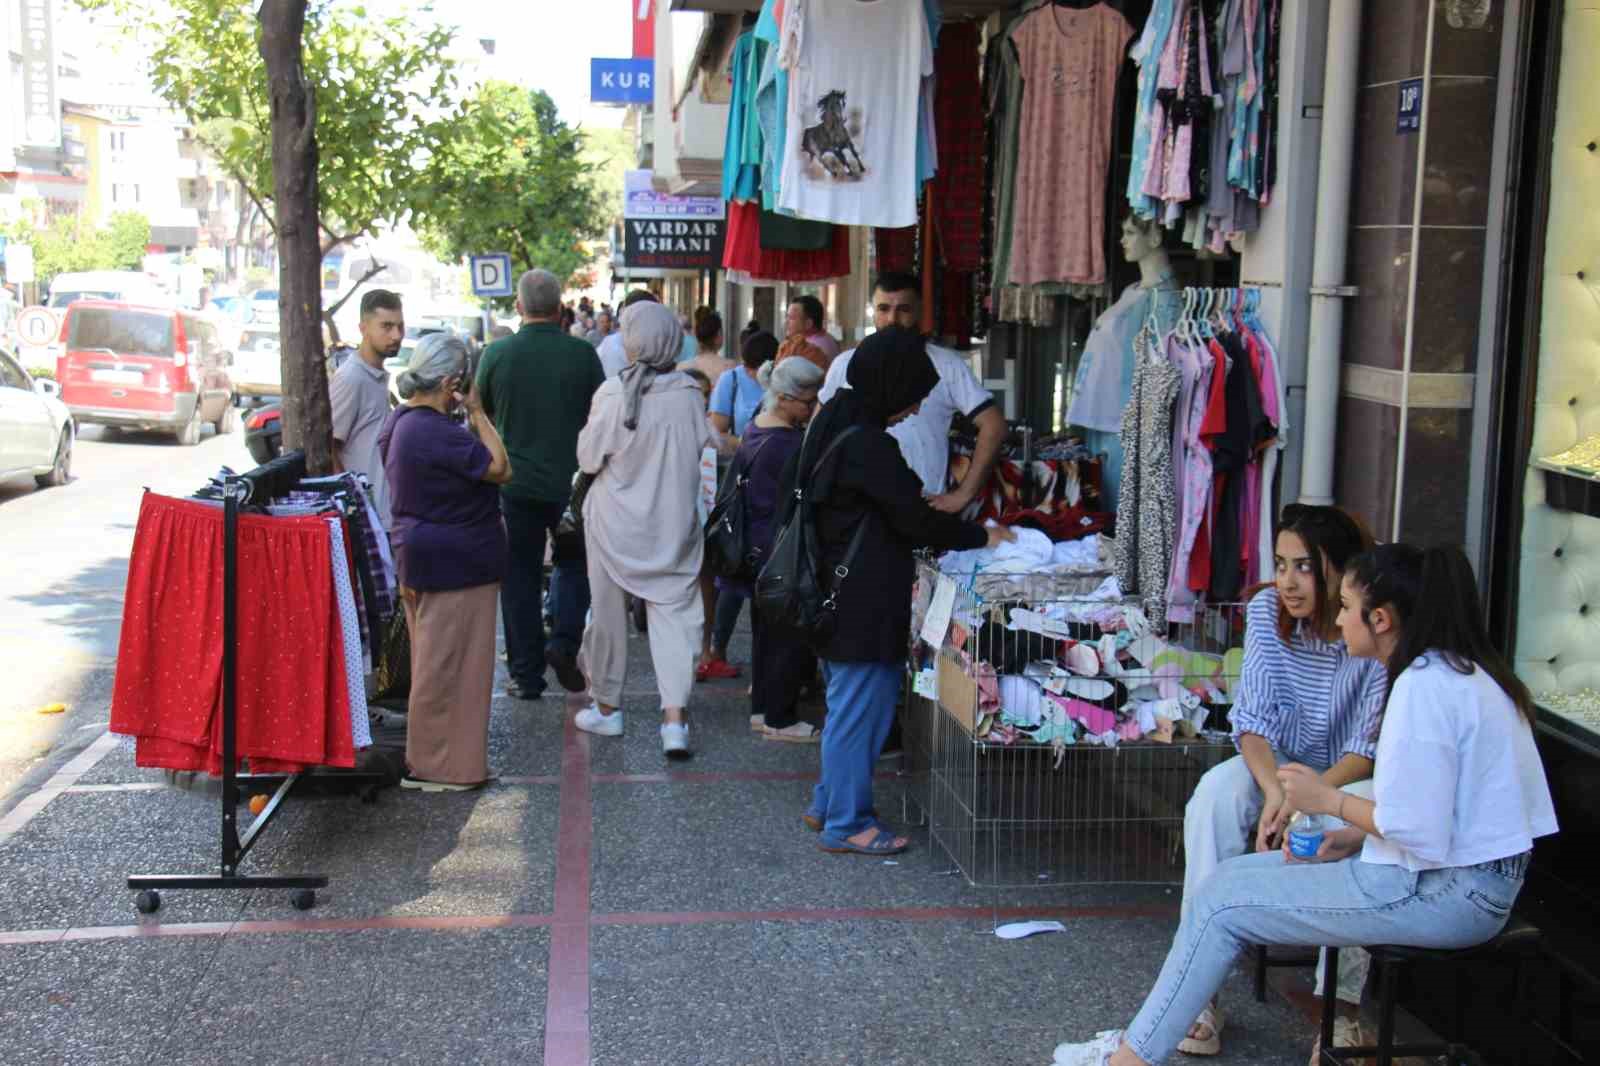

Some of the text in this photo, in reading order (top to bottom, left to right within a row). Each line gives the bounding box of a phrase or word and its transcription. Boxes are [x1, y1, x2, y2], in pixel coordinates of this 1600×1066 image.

[632, 221, 718, 236] VARDAR
[638, 236, 711, 254] İŞHANI
[481, 263, 498, 286] D
